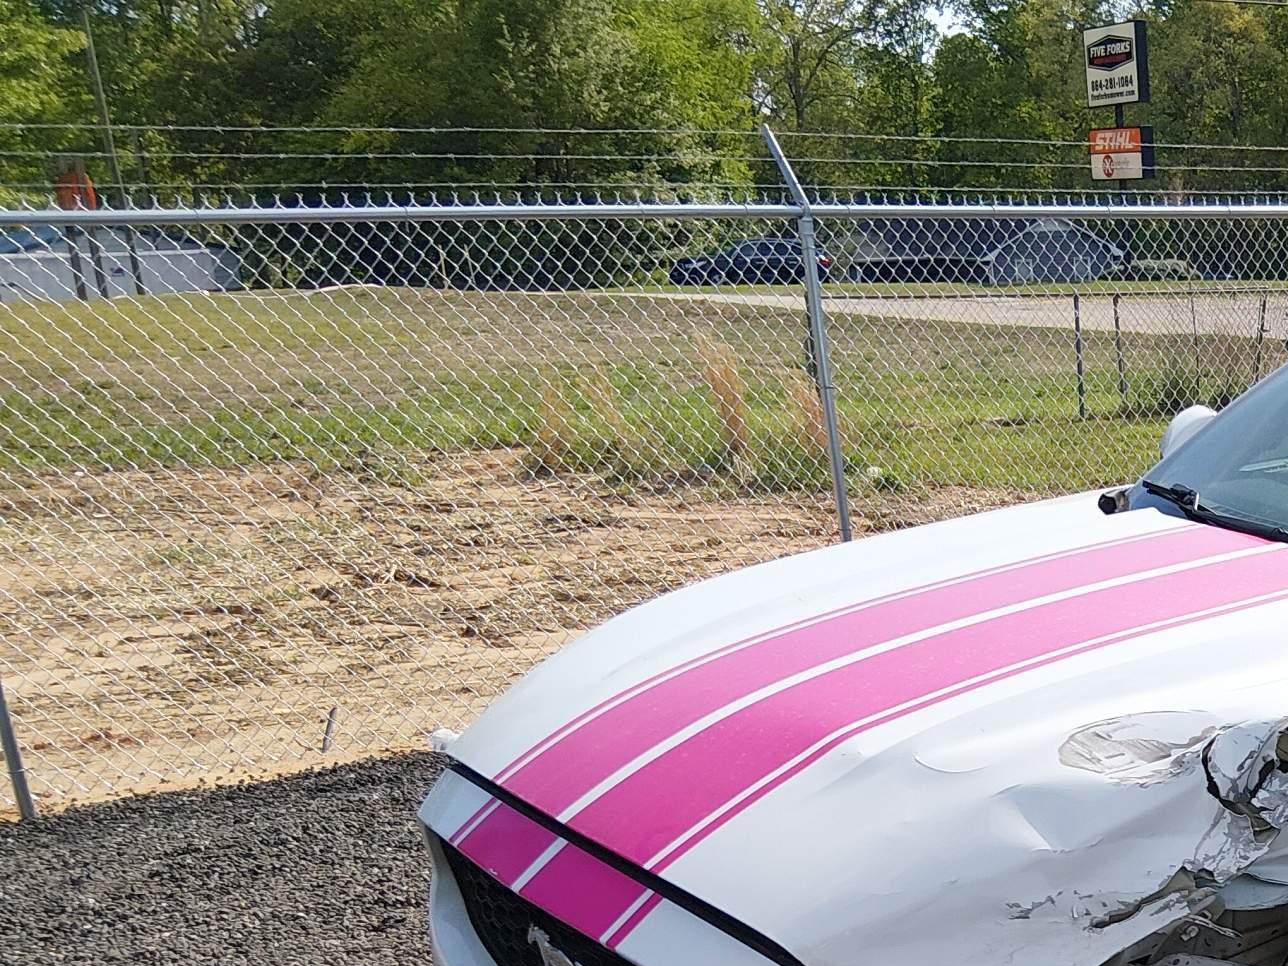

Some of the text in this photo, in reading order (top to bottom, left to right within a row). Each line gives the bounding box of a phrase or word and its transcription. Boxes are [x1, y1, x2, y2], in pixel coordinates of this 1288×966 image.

[1090, 41, 1130, 58] FIVE FORKS
[1095, 131, 1134, 150] STIHL
